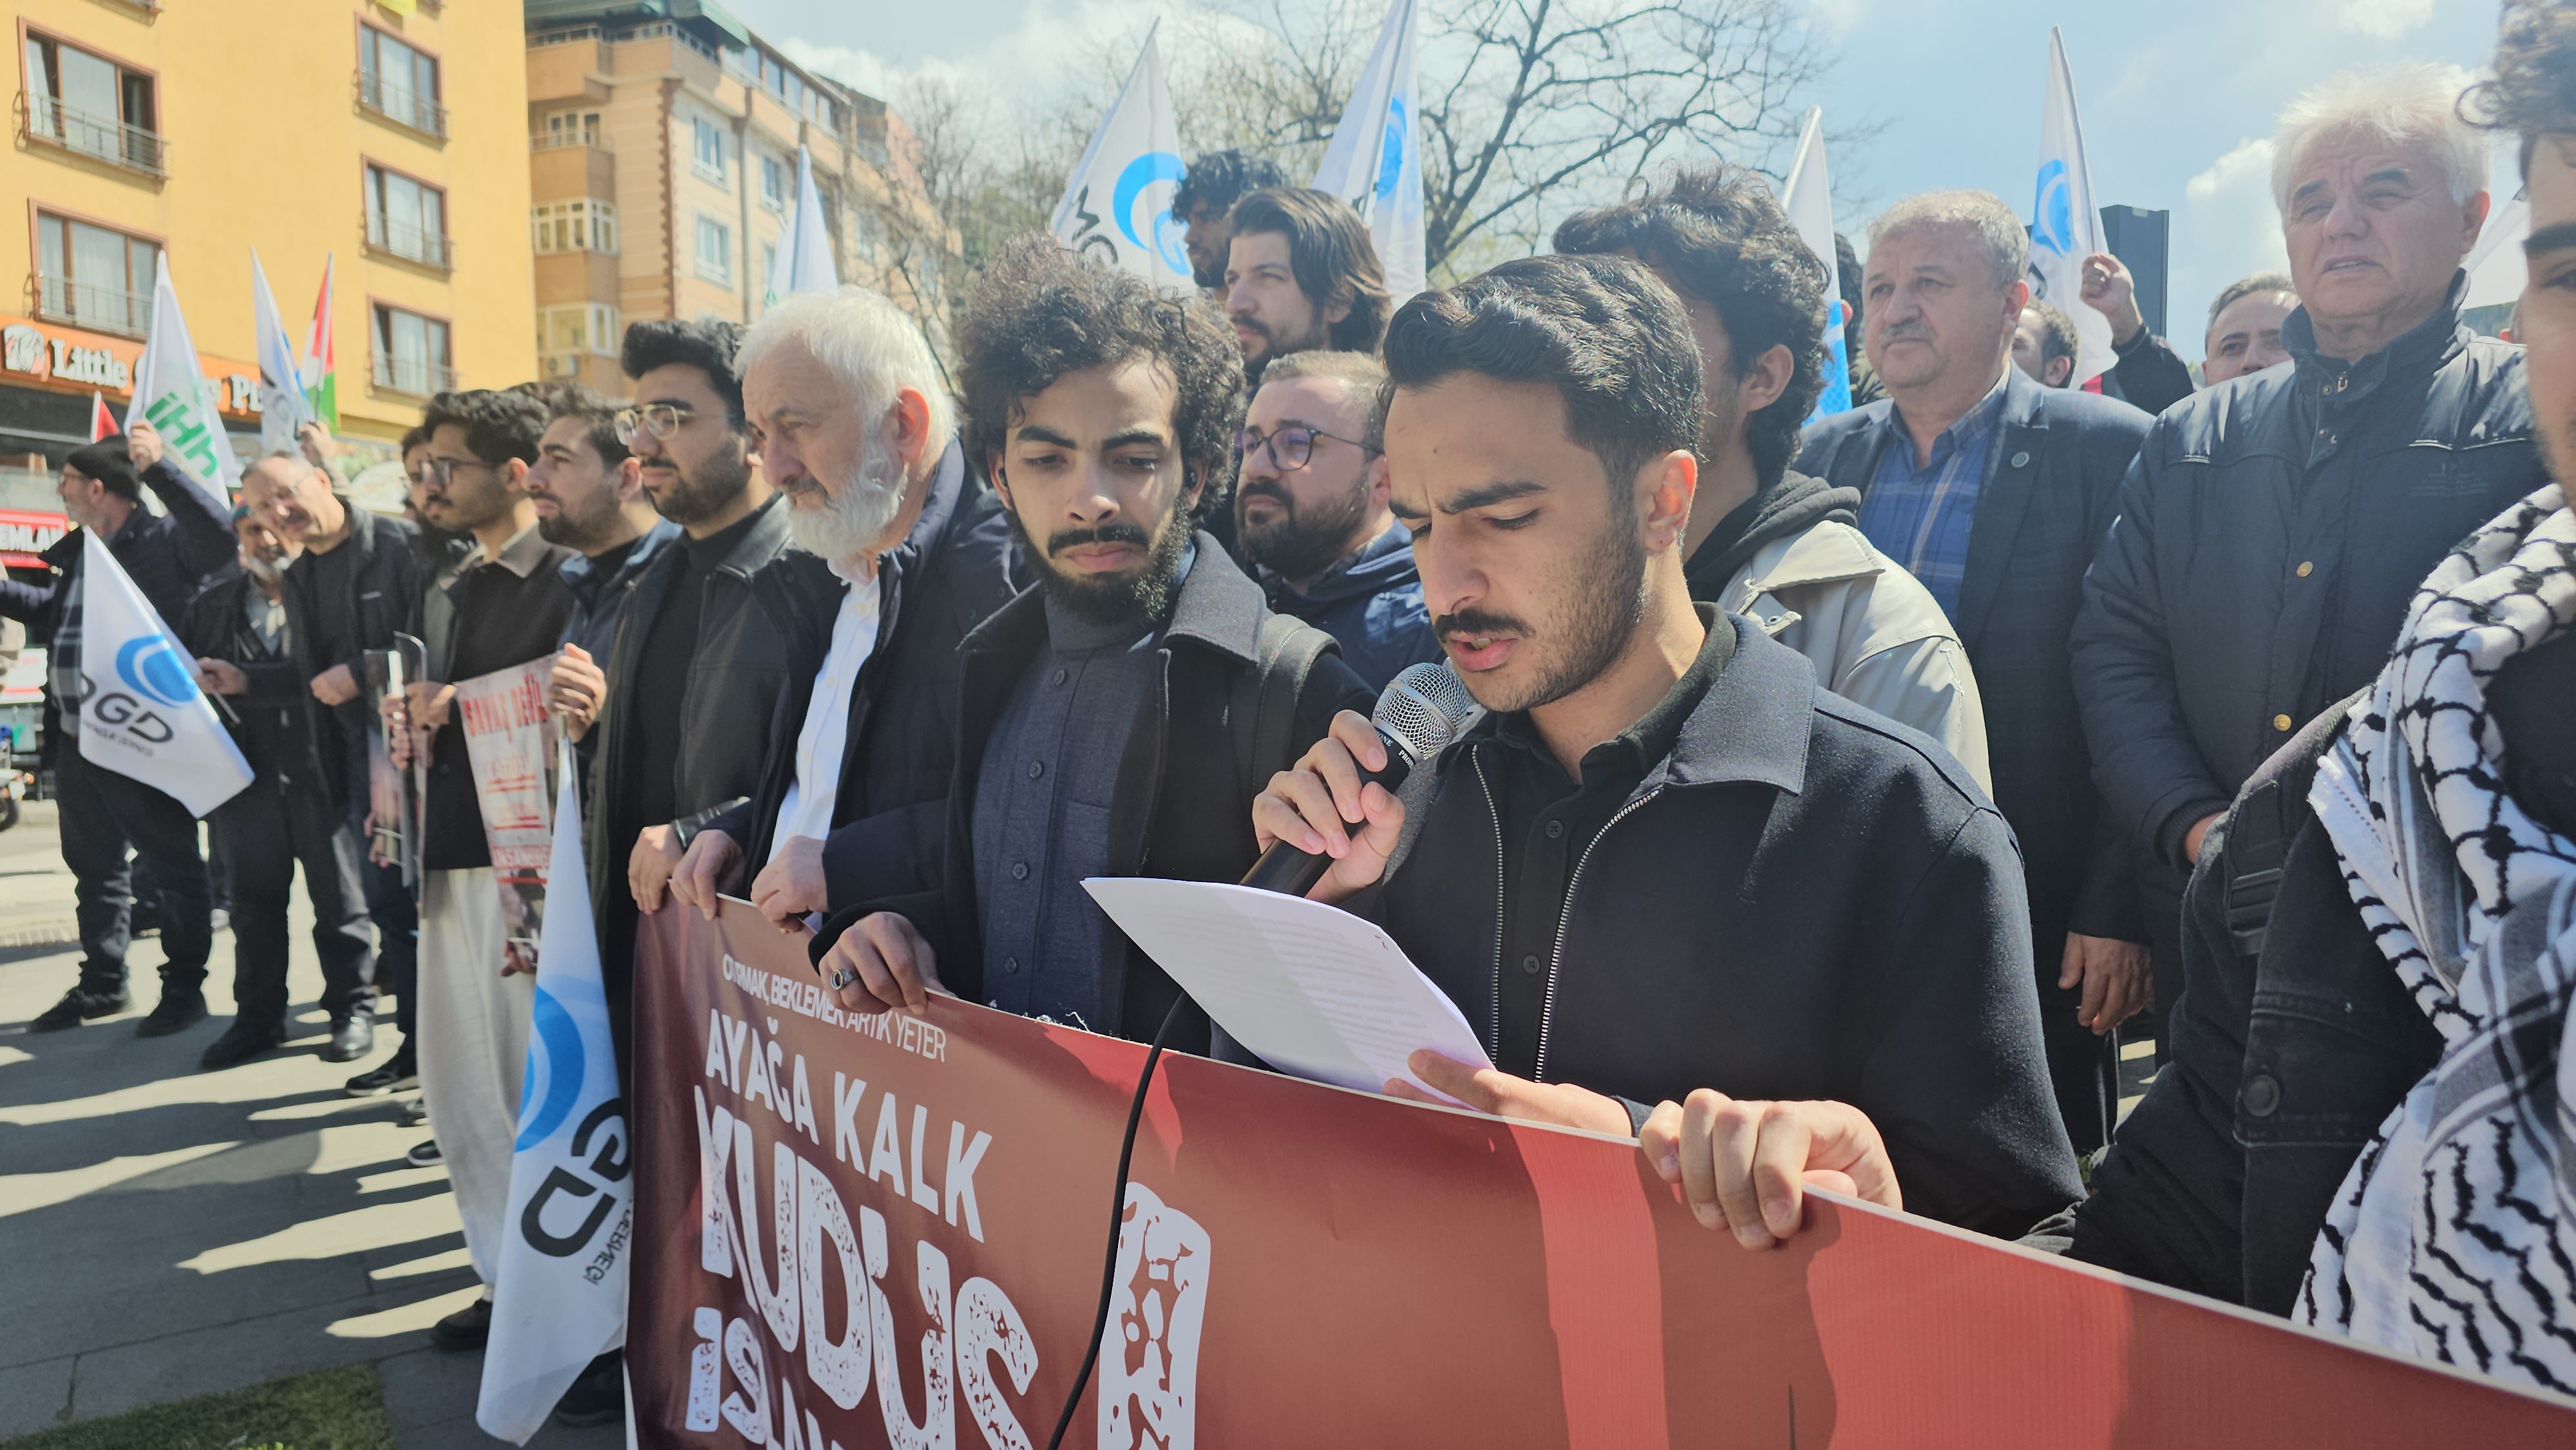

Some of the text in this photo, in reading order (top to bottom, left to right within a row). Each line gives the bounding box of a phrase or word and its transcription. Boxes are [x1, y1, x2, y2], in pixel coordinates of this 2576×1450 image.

[51, 339, 128, 388] Little
[895, 1012, 947, 1062] YETER
[705, 1008, 992, 1243] AYAĞA KALK
